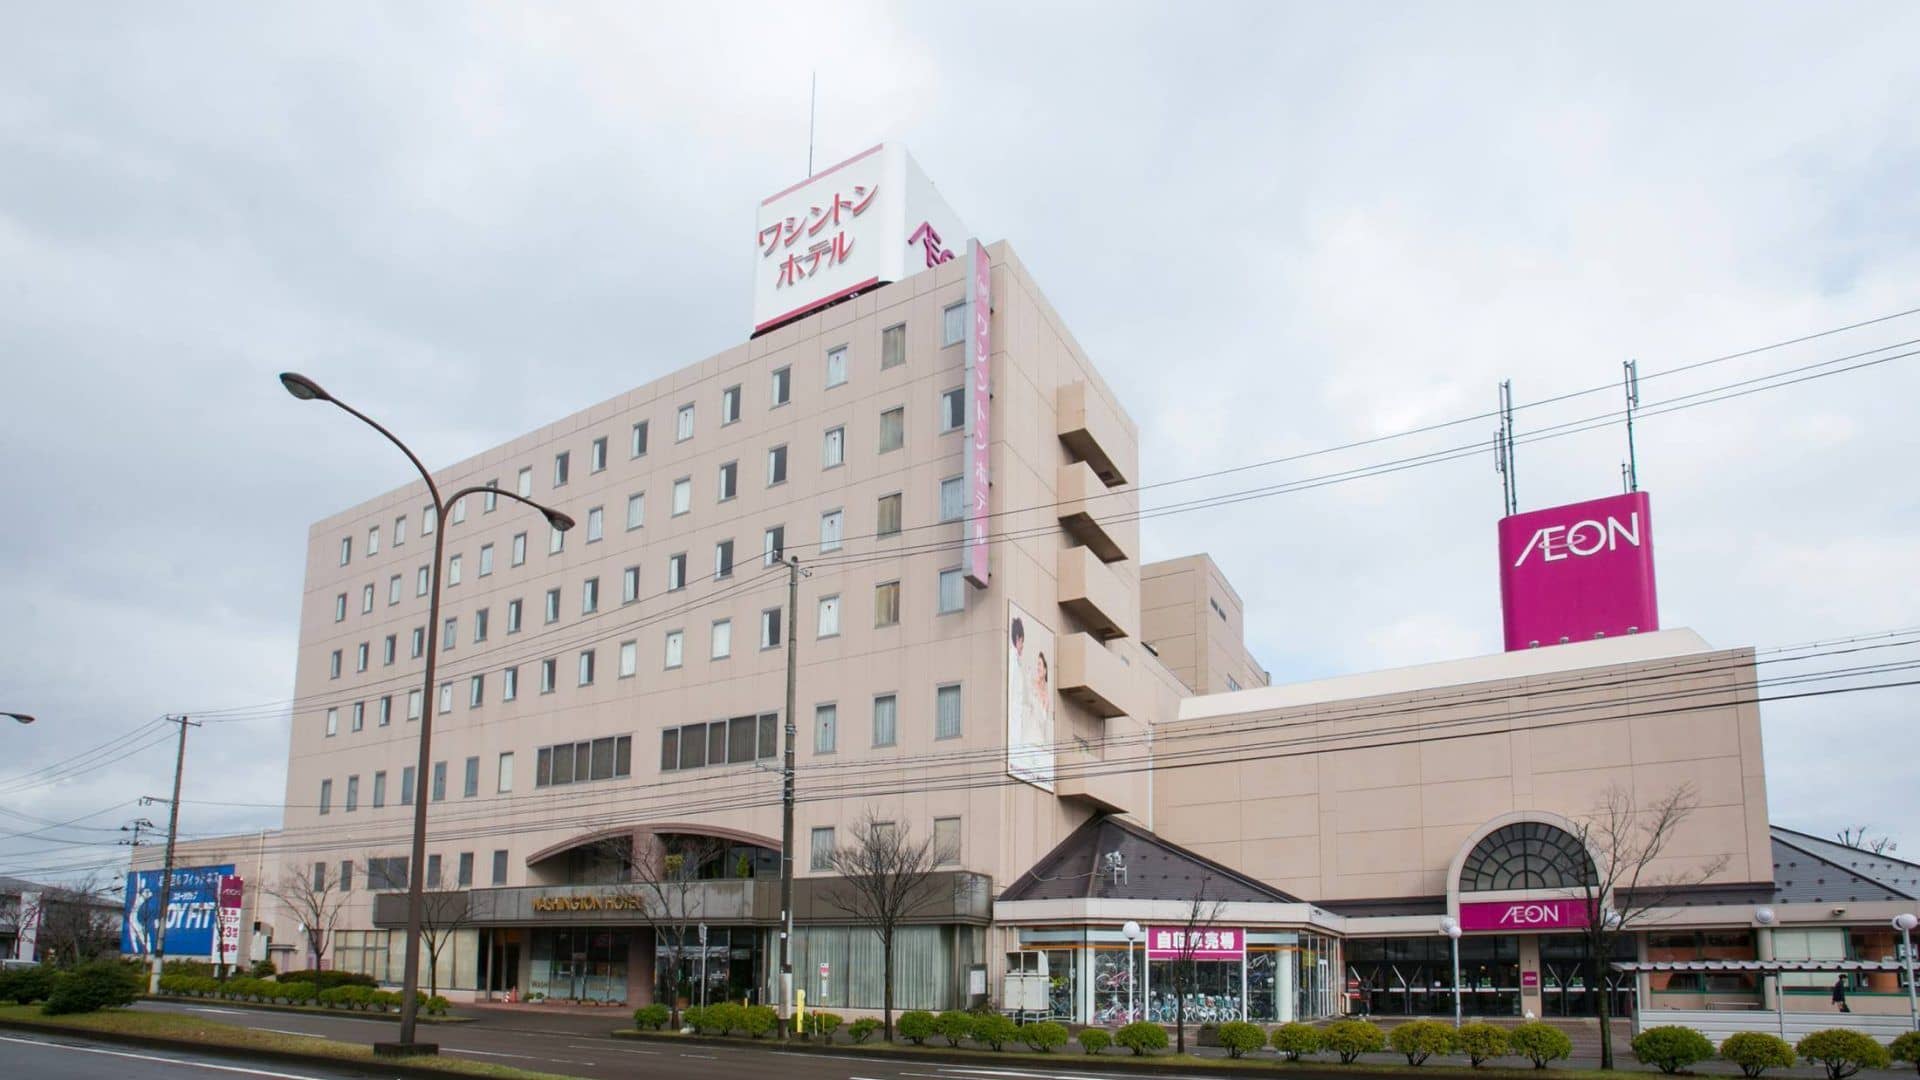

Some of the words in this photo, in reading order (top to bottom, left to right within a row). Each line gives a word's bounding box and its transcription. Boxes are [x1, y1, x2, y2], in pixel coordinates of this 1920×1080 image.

[759, 185, 878, 257] ワシントン
[776, 231, 855, 289] ホテル
[976, 312, 988, 544] ワシントンホテル
